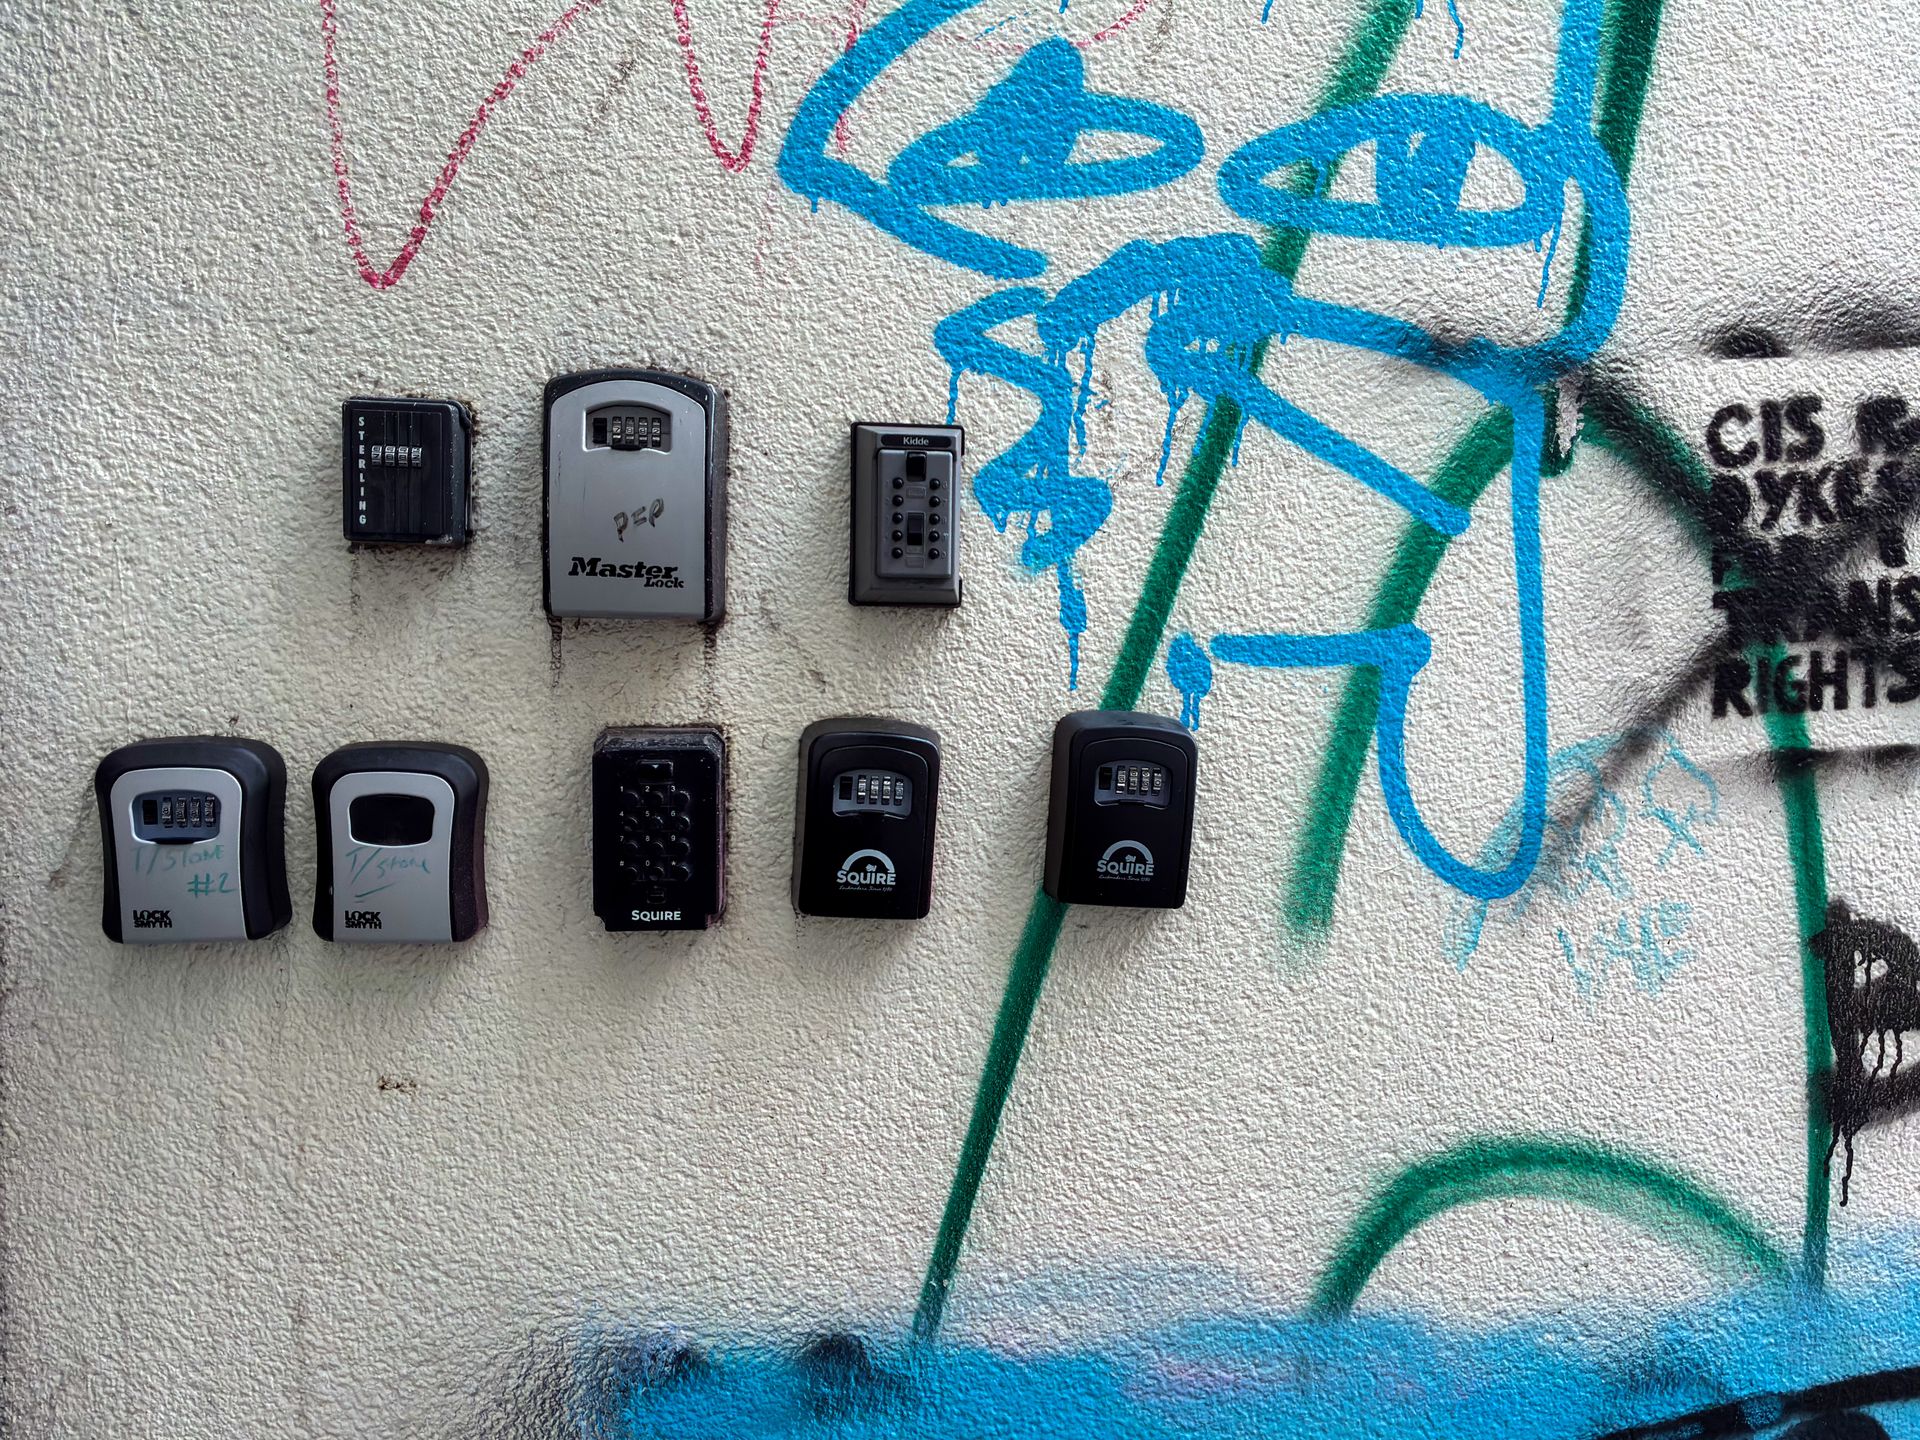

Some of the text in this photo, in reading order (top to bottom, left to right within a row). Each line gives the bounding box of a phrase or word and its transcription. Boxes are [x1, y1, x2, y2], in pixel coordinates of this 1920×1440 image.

[1706, 395, 1825, 468] CIS
[903, 436, 930, 446] Kidde
[358, 416, 367, 525] STERLING
[568, 557, 679, 579] Master
[643, 577, 685, 589] Lock
[1712, 648, 1920, 718] RIGHTS
[1096, 859, 1155, 876] SQUIRE
[836, 869, 897, 886] SQUIRE
[133, 909, 171, 920] LOCK
[344, 910, 381, 921] LOCK
[631, 910, 682, 922] SQUIRE
[134, 919, 173, 929] SMYTH
[345, 920, 382, 930] SMYTH
